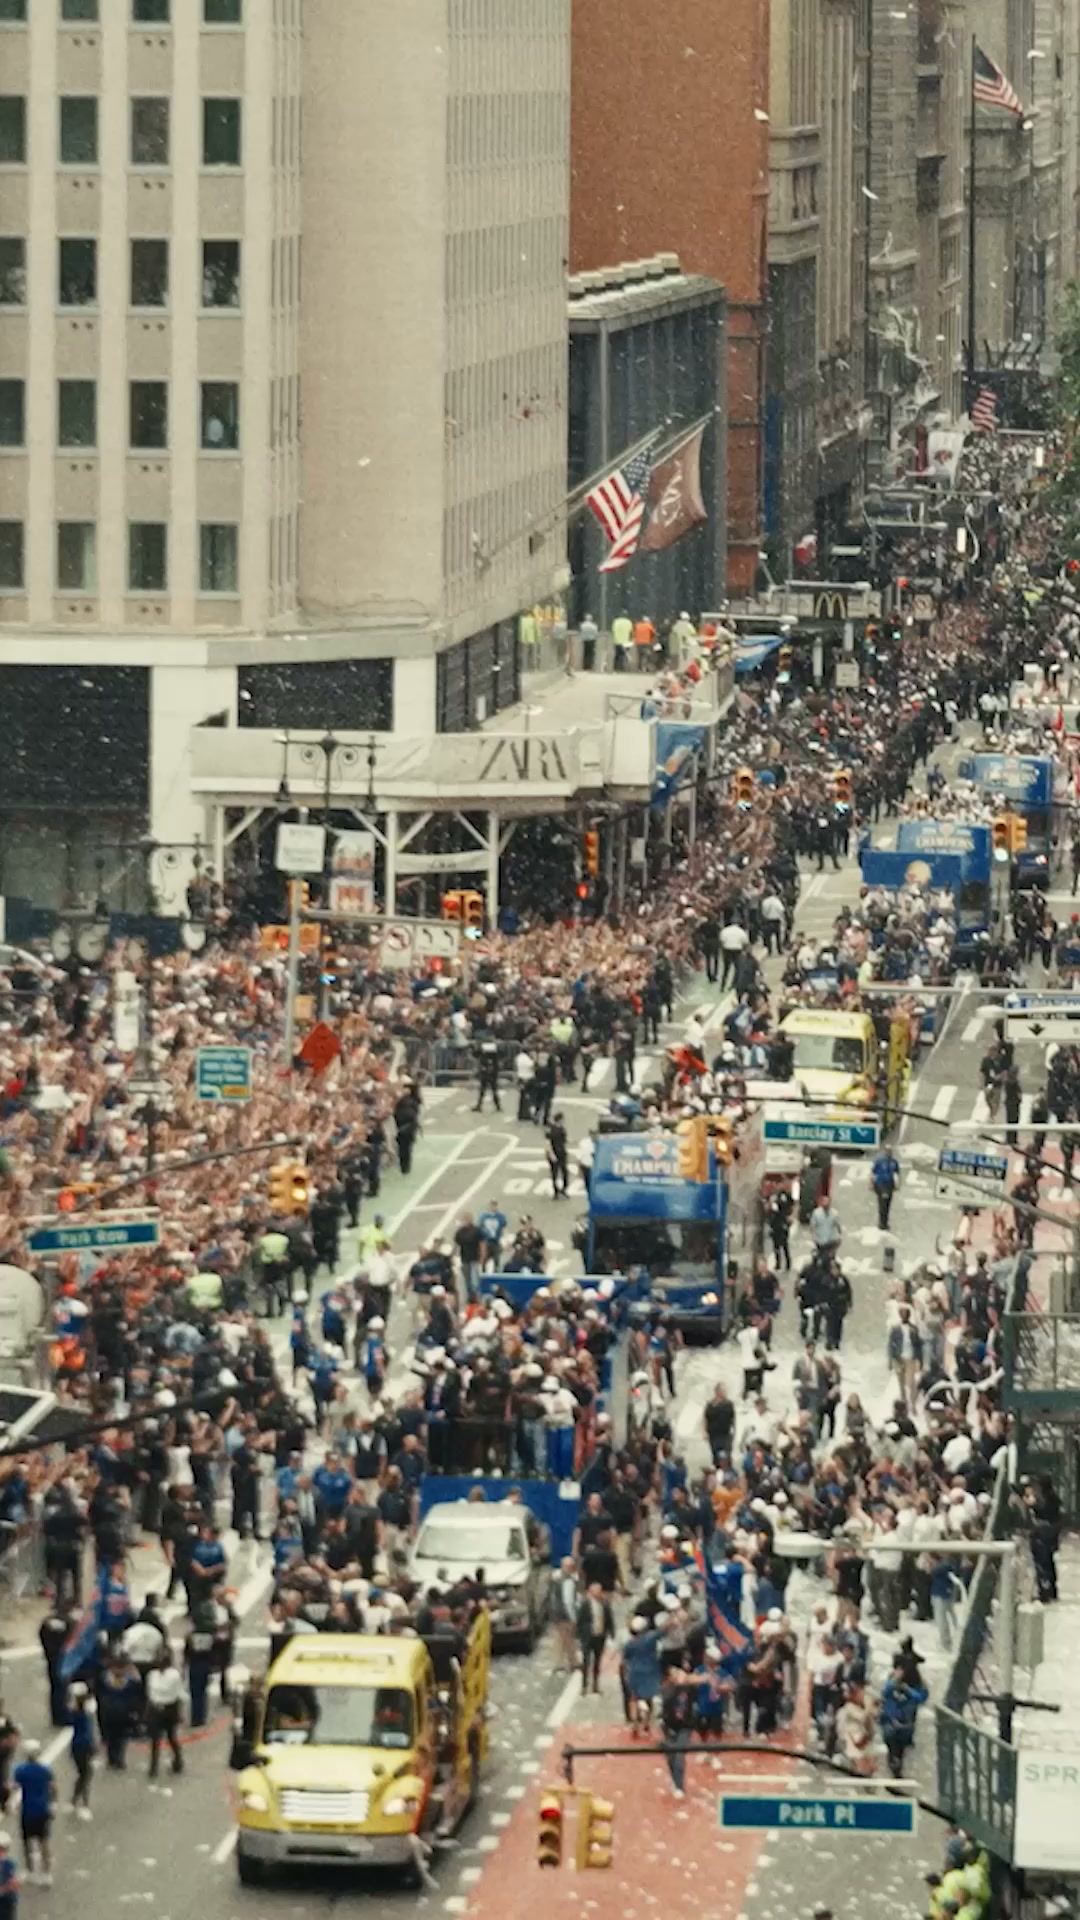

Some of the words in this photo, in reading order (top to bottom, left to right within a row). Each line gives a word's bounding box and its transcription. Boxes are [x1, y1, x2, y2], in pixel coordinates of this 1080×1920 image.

[479, 739, 567, 780] ZARA
[787, 1123, 835, 1141] Barclay
[838, 1127, 851, 1140] St
[58, 1231, 91, 1246] Park
[96, 1229, 128, 1243] Row
[778, 1803, 826, 1825] Park
[834, 1804, 856, 1826] Pl
